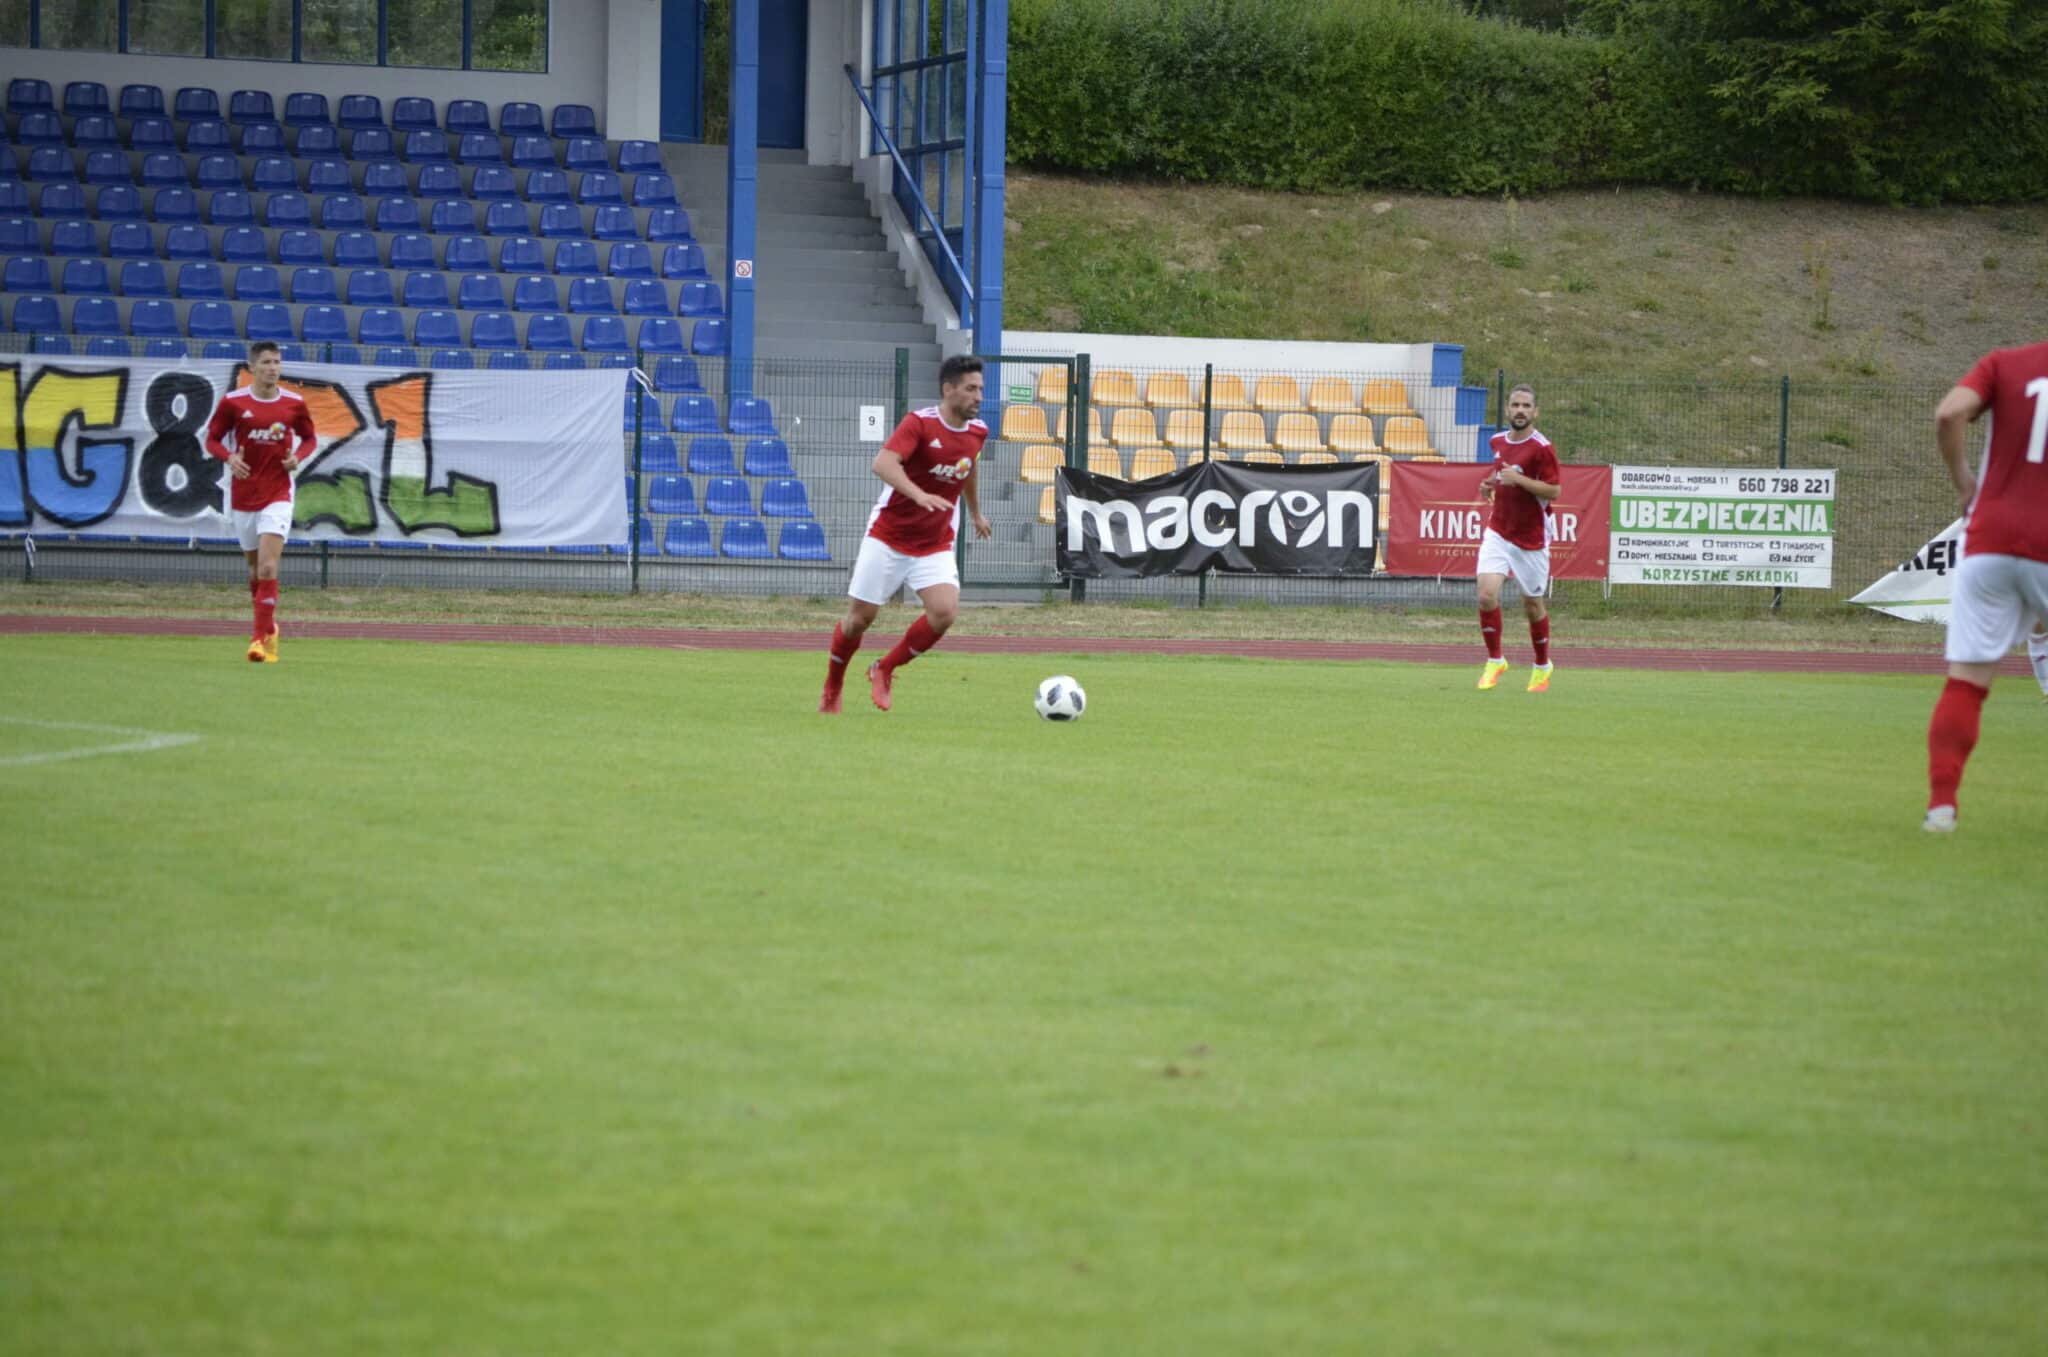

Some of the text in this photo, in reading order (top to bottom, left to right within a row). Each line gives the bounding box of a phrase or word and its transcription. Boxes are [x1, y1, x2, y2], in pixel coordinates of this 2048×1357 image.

[868, 415, 876, 426] 9
[1621, 473, 1671, 483] ODARGOWO
[1738, 477, 1830, 494] 660 798 221
[1066, 488, 1374, 553] macron
[1619, 500, 1829, 532] UBEZPIECZENIA
[1419, 509, 1482, 541] KING
[1642, 567, 1799, 583] KORZYSTNE SKŁADKI
